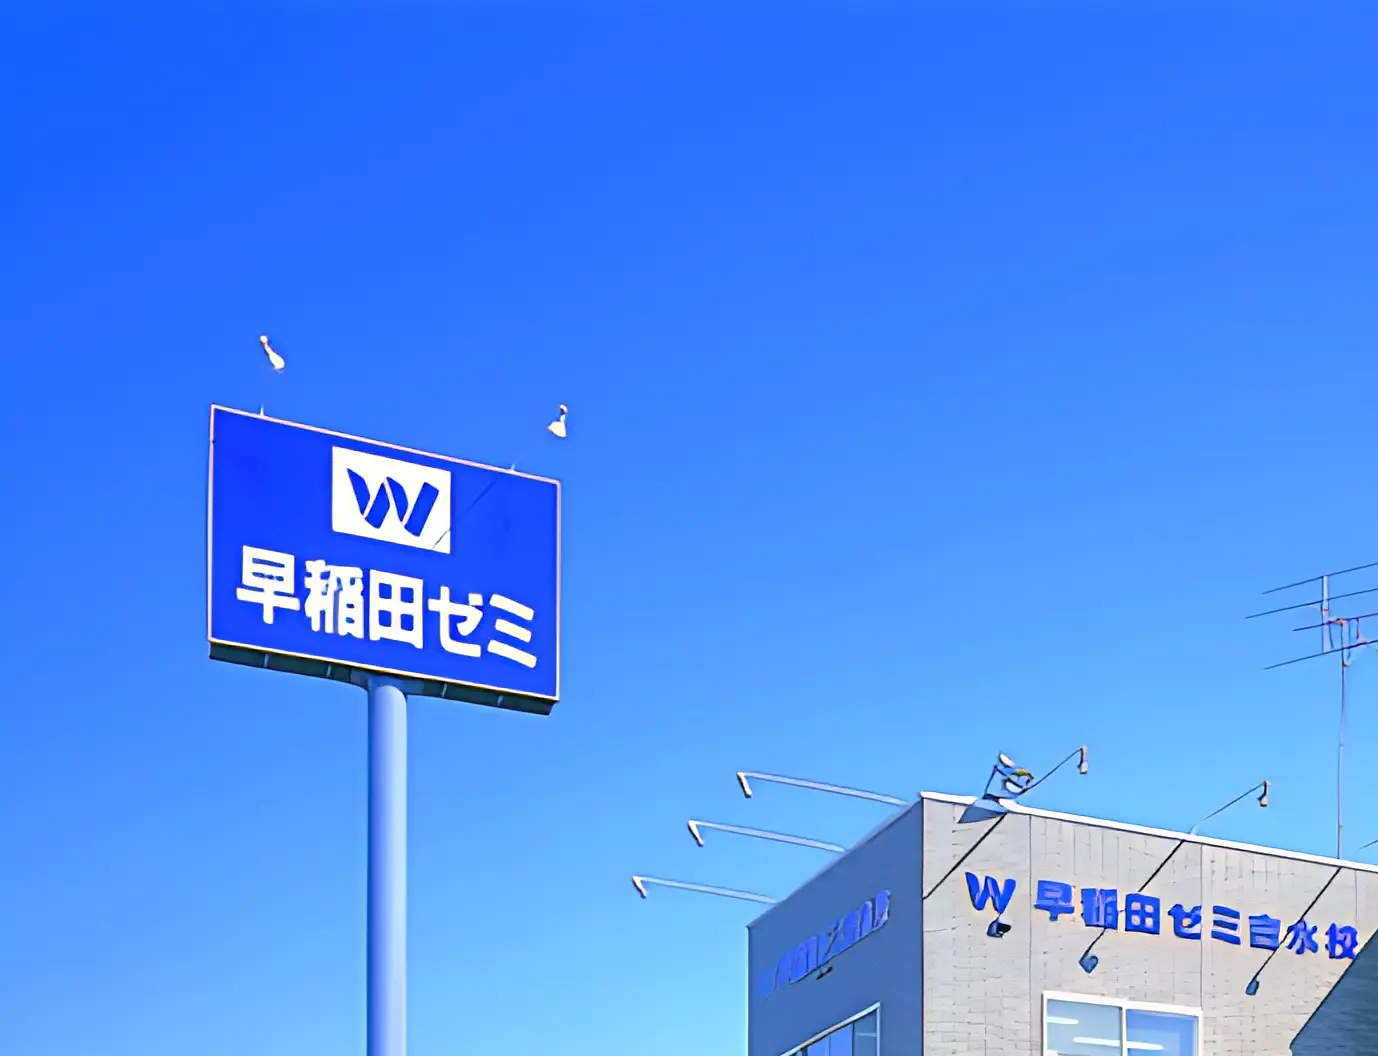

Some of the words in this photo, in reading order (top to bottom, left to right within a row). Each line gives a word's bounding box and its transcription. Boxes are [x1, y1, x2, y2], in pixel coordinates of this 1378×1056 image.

[346, 467, 440, 538] W
[235, 544, 538, 669] 早稲田ゼミ
[965, 871, 1017, 914] W
